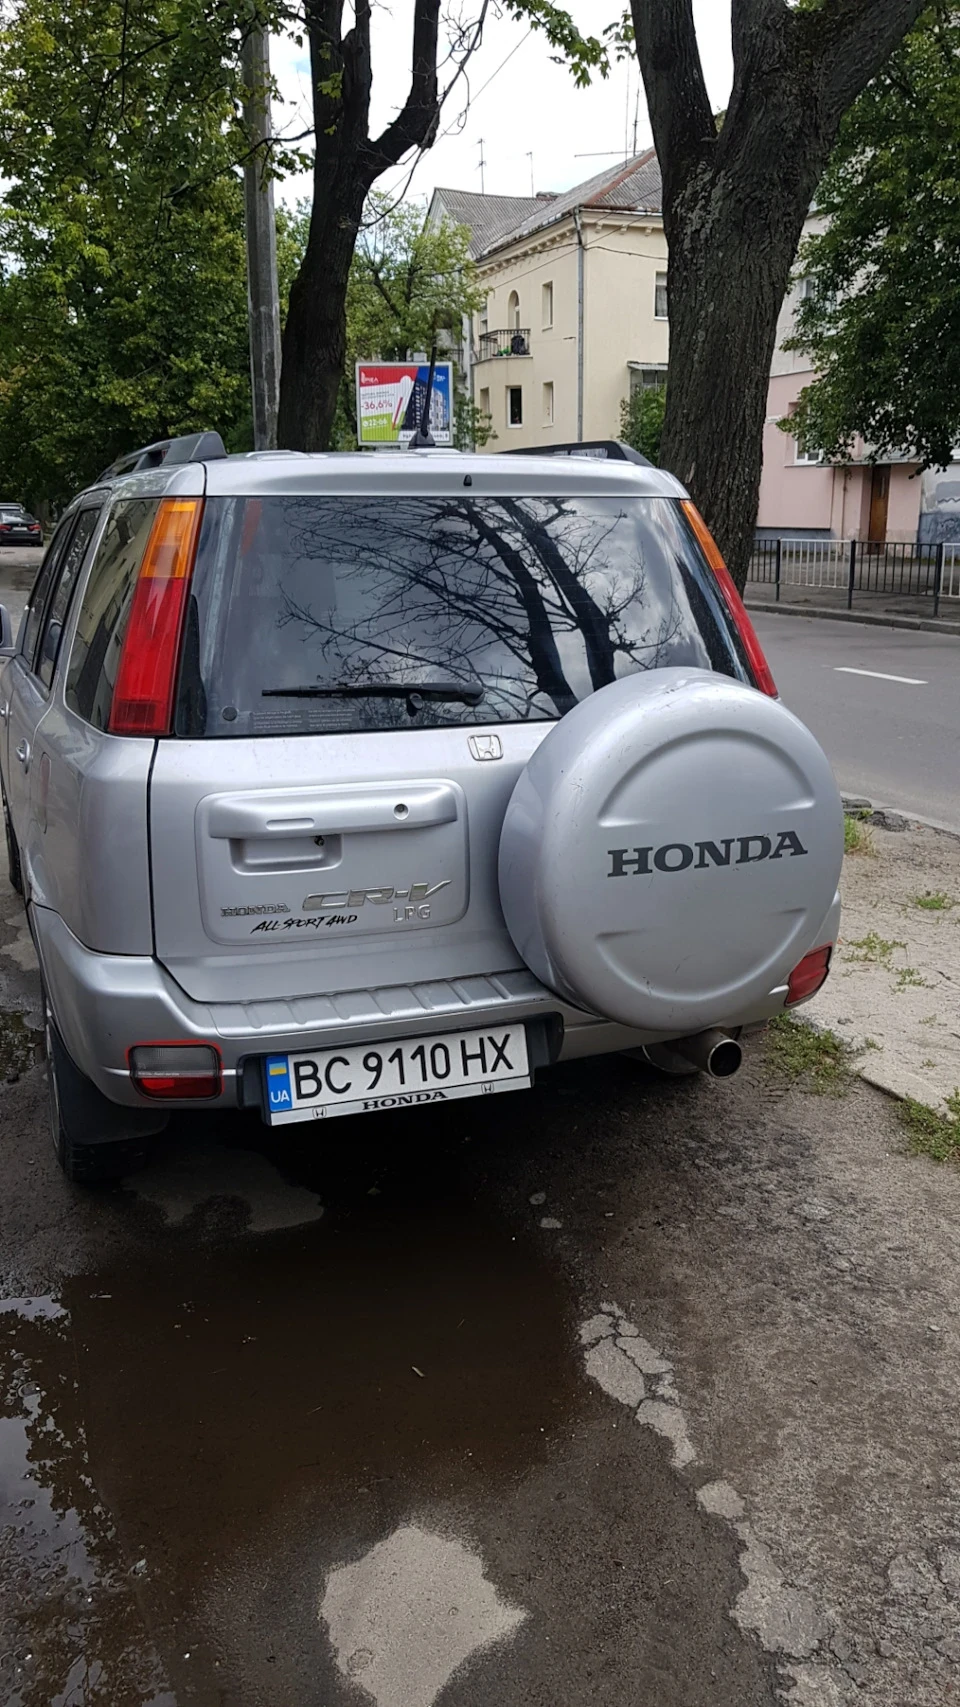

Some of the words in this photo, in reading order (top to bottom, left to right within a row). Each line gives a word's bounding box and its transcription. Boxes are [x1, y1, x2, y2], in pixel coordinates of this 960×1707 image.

[607, 830, 809, 877] HONDA
[220, 903, 290, 917] HONDA
[302, 880, 452, 911] CR-V
[393, 904, 431, 922] LPG
[293, 1056, 352, 1100] BC
[363, 1042, 451, 1090] 9110
[460, 1033, 514, 1077] HX
[271, 1091, 290, 1104] UA
[363, 1091, 448, 1111] HONDA
